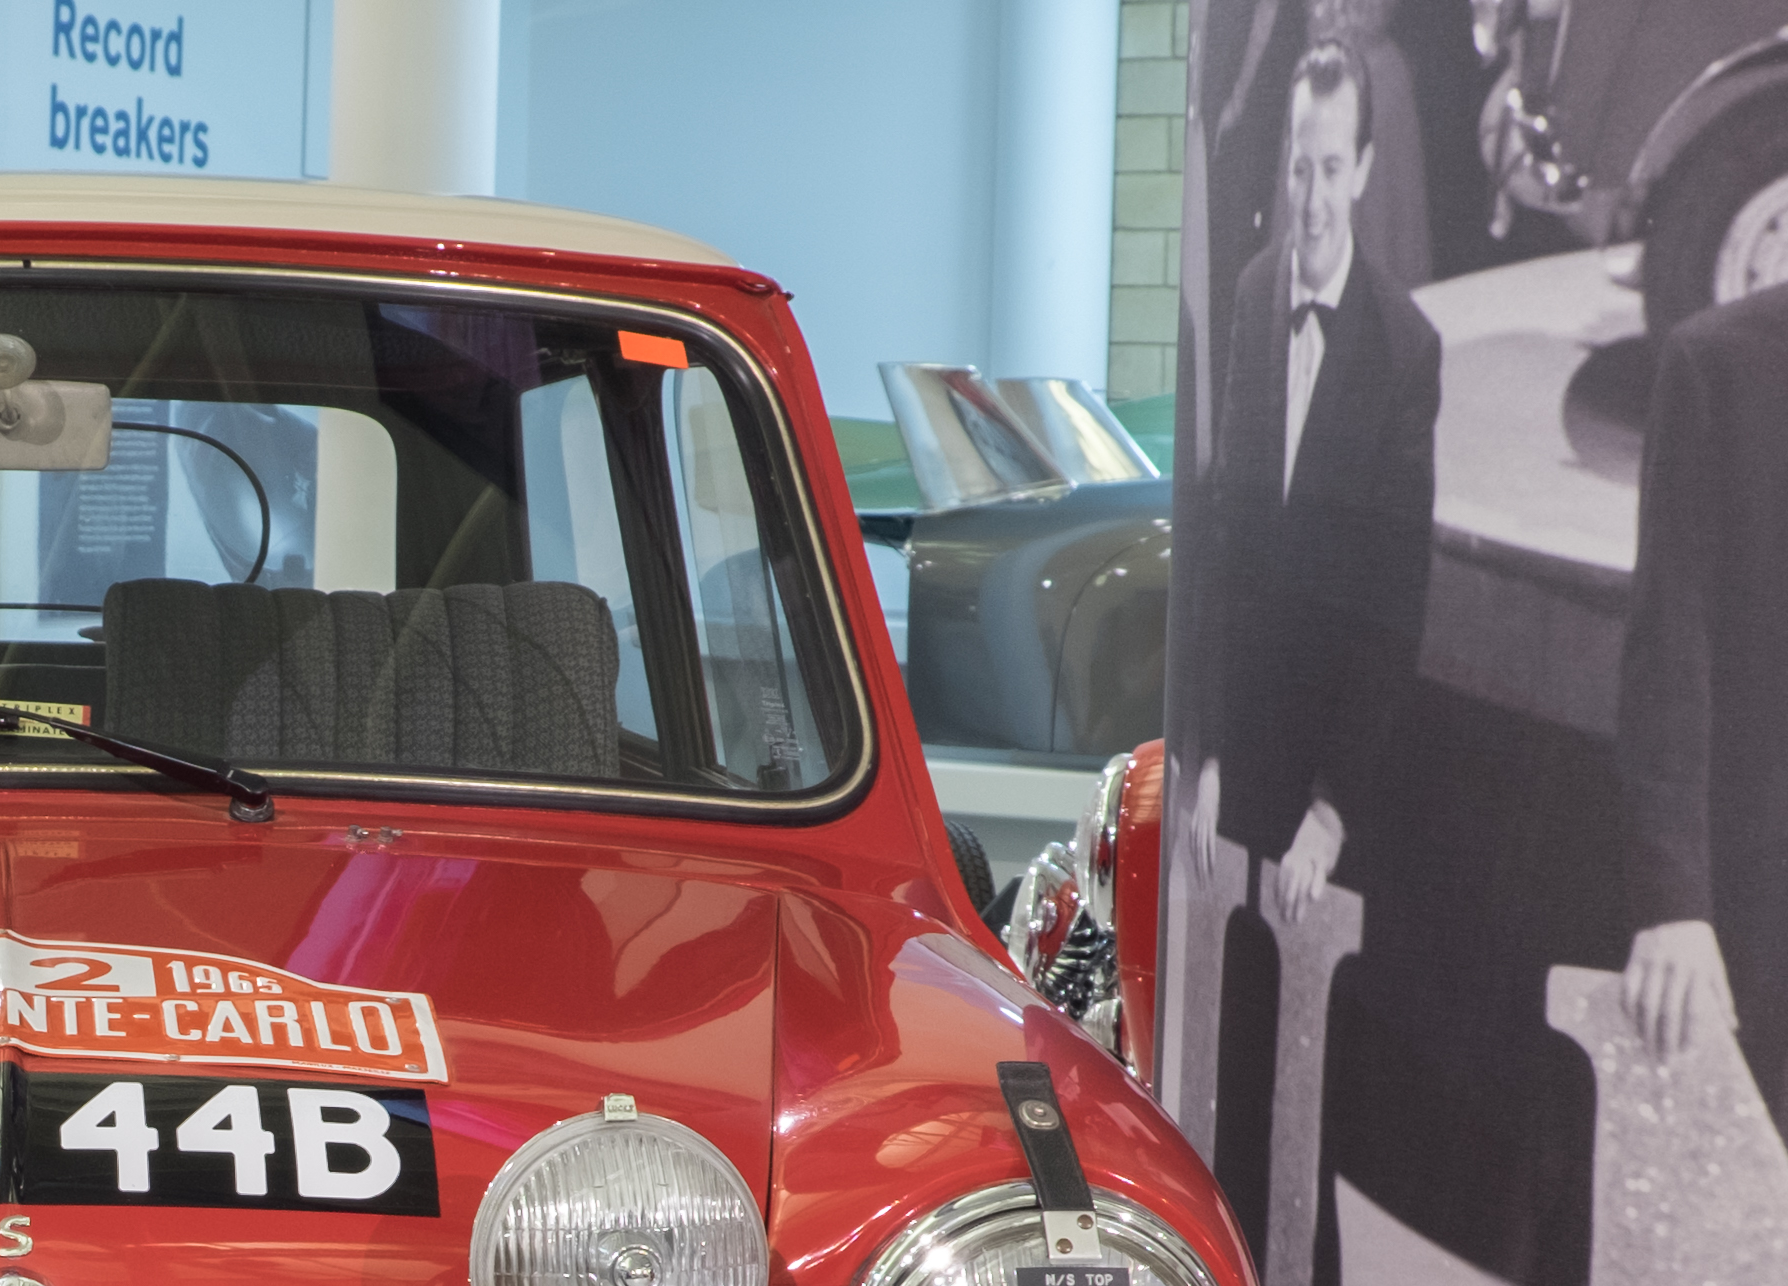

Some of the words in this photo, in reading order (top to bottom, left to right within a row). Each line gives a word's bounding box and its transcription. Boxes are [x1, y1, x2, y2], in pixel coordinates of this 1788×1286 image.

[52, 0, 184, 77] Record
[50, 82, 209, 168] breakers
[1, 704, 76, 715] TRIPLEX
[165, 960, 283, 994] 1965
[61, 1082, 403, 1200] 44B
[1045, 1273, 1076, 1286] N/S
[1085, 1273, 1114, 1286] TOP
